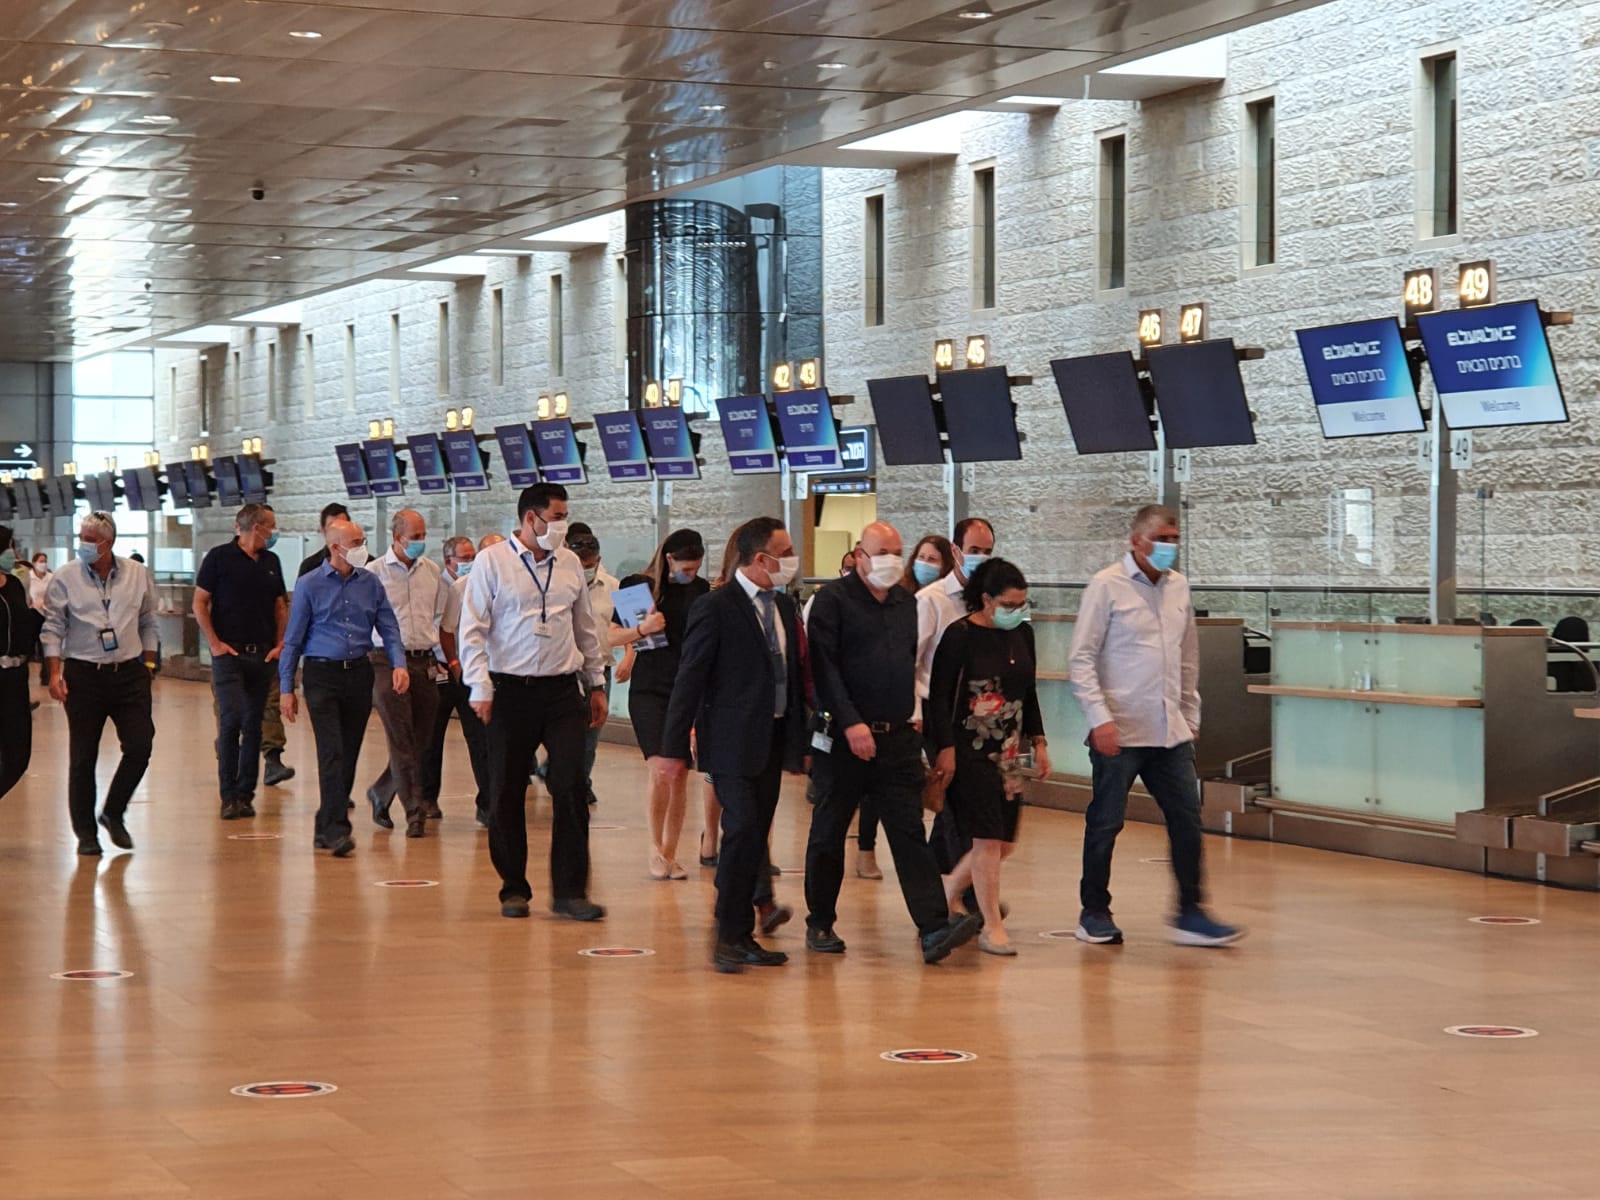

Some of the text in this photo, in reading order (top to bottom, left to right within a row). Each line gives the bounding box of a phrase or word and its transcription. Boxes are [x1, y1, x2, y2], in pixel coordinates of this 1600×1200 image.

[1405, 274, 1433, 306] 48
[1461, 267, 1489, 301] 49
[1140, 313, 1160, 341] 46
[1181, 308, 1202, 337] 47
[936, 343, 952, 367] 44
[967, 339, 985, 364] 45
